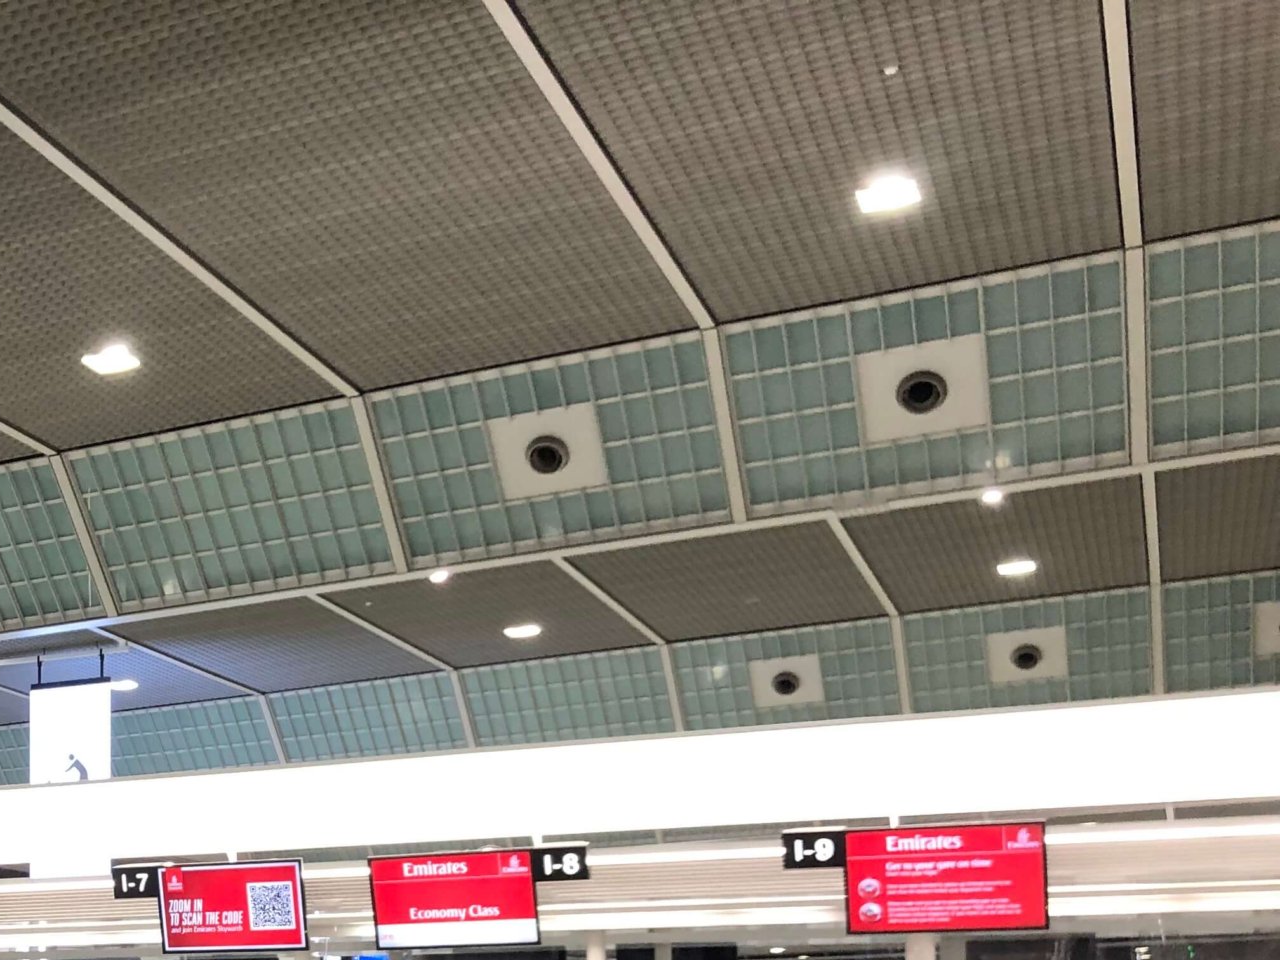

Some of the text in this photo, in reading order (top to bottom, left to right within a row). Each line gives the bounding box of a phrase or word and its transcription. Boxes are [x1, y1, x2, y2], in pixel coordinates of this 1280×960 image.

[794, 838, 835, 862] I-9
[885, 834, 963, 852] Emirates
[402, 861, 468, 878] Emirates
[542, 853, 580, 876] I-8
[121, 873, 149, 892] I-7
[168, 898, 203, 912] ZOOM IN
[409, 904, 501, 922] Economy Class
[170, 910, 244, 926] TO SCAN THE CODE
